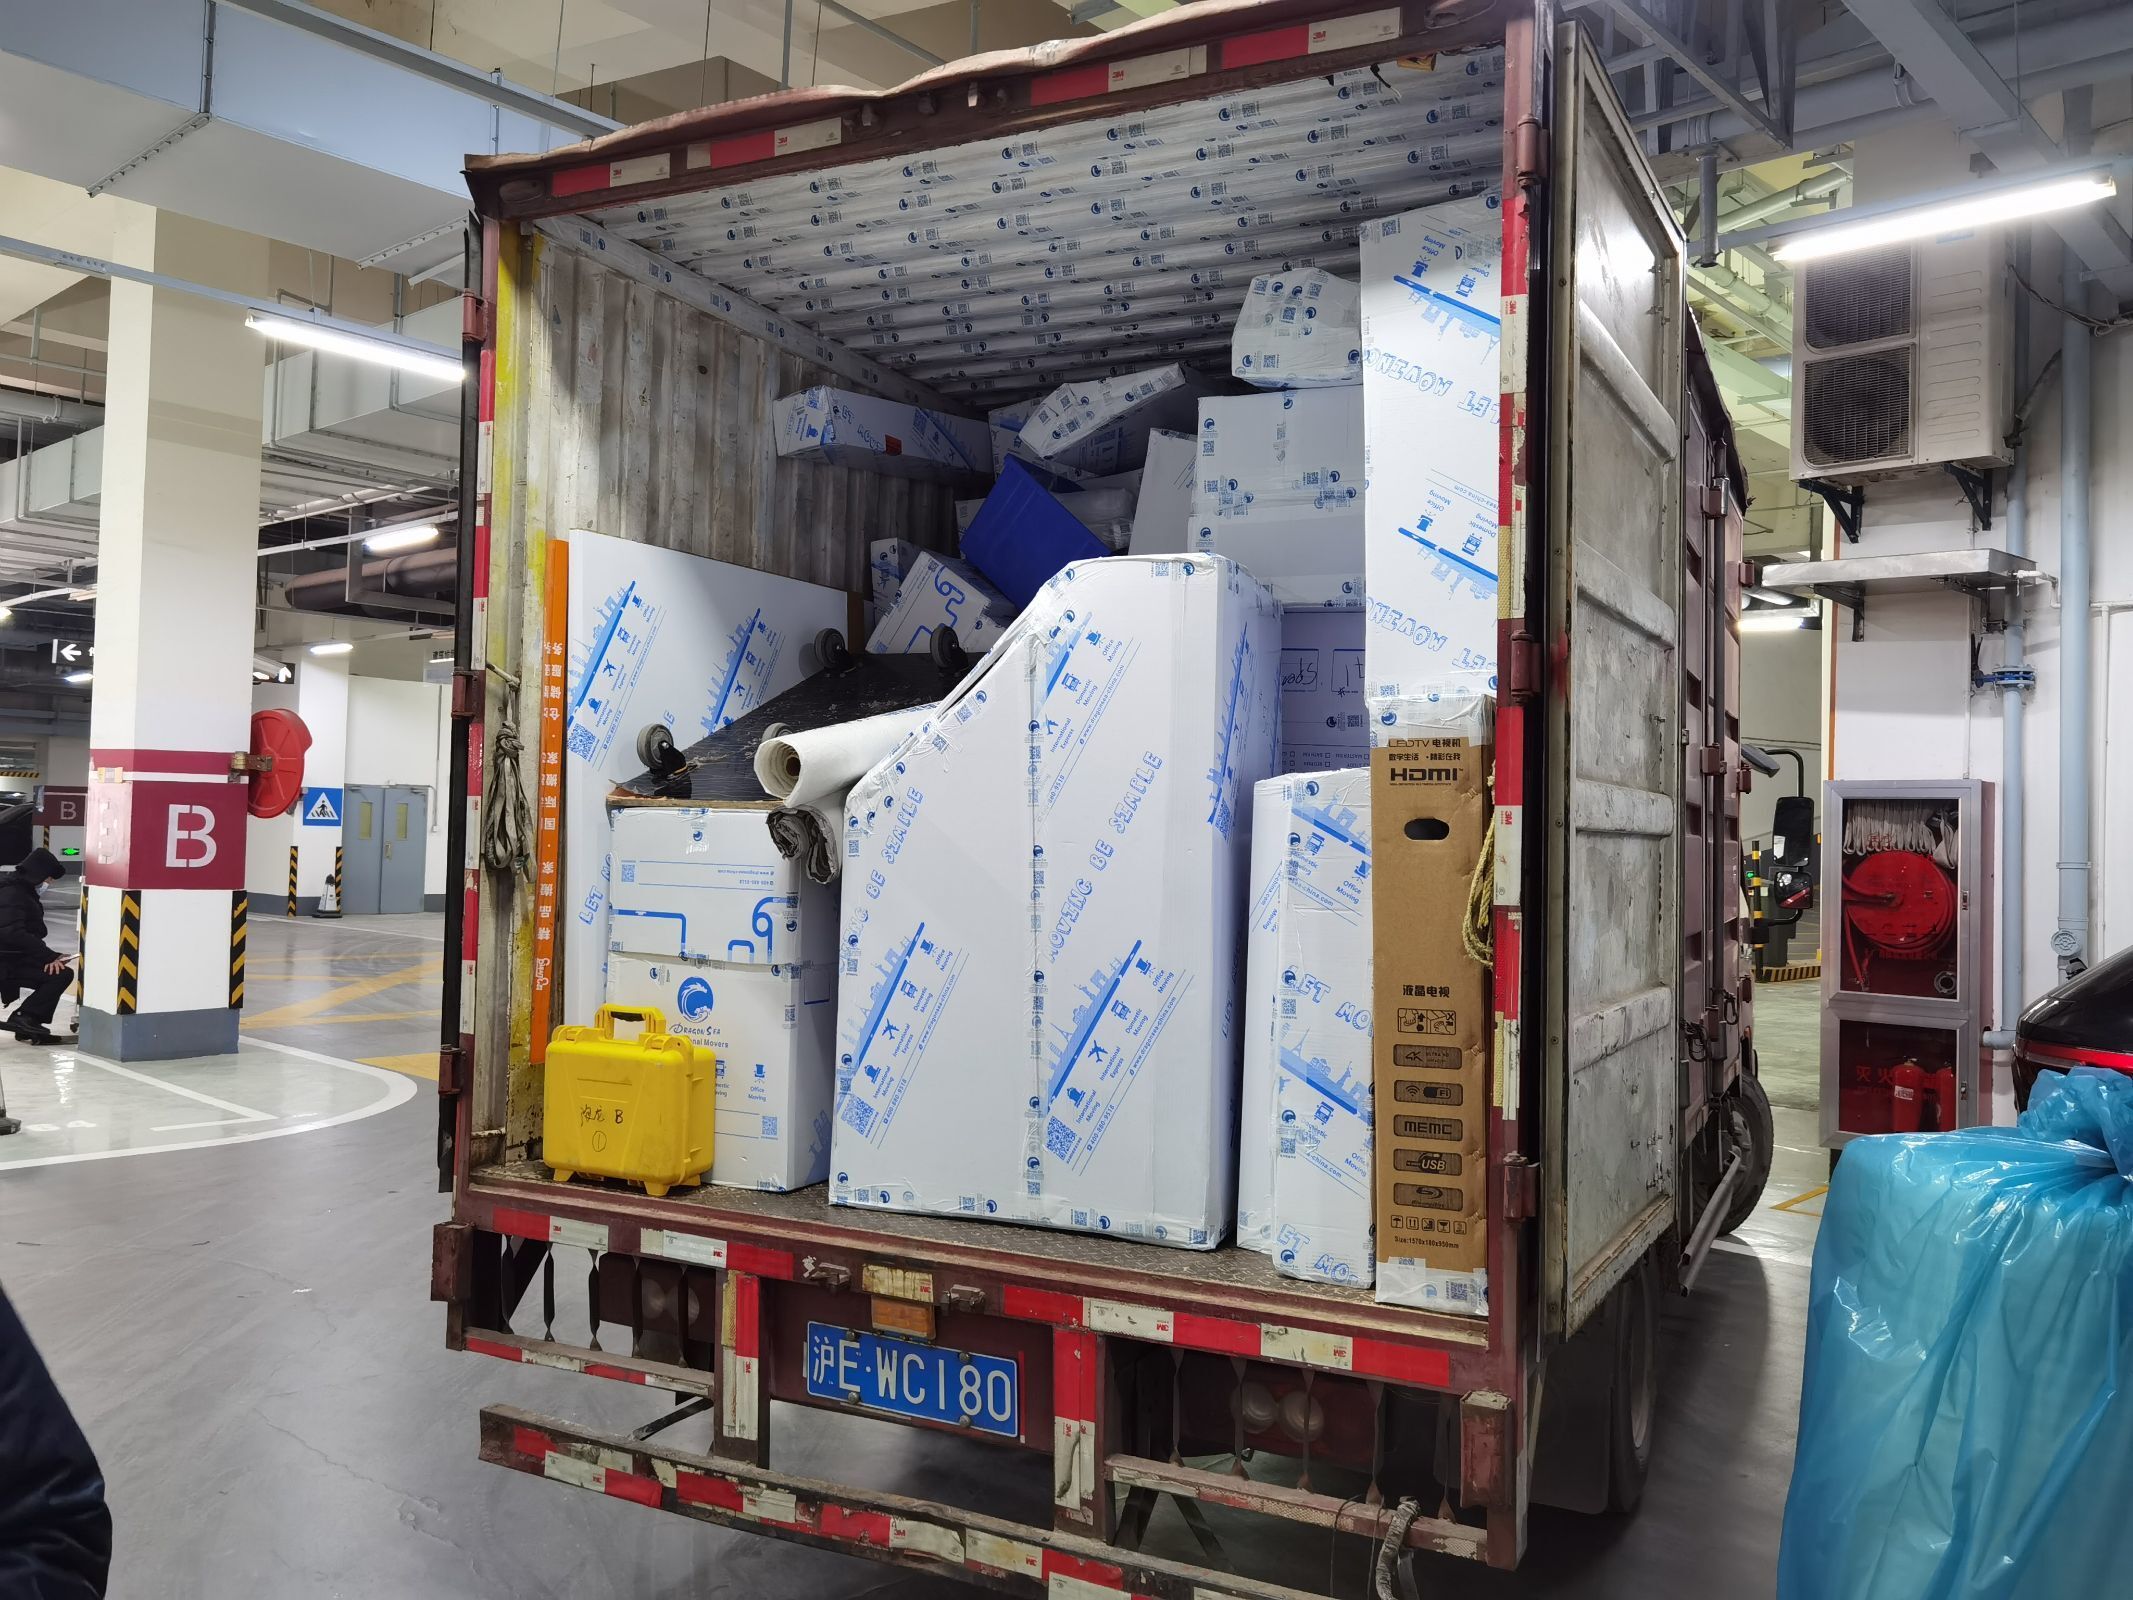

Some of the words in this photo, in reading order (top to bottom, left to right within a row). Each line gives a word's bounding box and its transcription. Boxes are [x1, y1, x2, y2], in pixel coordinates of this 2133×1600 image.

[1421, 245, 1439, 257] Office
[1423, 234, 1446, 249] Moving
[1510, 301, 1517, 314] 3M
[1426, 498, 1445, 512] Office
[1429, 489, 1452, 507] Moving
[1468, 520, 1497, 538] Domestic
[1475, 513, 1498, 529] Moving
[1102, 638, 1114, 656] Office
[1107, 640, 1123, 662] Moving
[1075, 678, 1093, 706] Domestic
[1083, 685, 1099, 707] Moving
[1050, 717, 1072, 753] International
[1061, 728, 1074, 750] Express
[1432, 738, 1461, 747] 电视机
[1389, 753, 1419, 761] 数字生活
[1390, 767, 1458, 781] HDMI
[60, 801, 77, 820] B
[1506, 811, 1513, 825] 3M
[165, 803, 218, 868] B
[865, 868, 887, 900] BE
[1343, 880, 1362, 895] Office
[1044, 878, 1093, 964] MOVING
[1089, 838, 1114, 872] BE
[1335, 886, 1361, 905] Moving
[578, 886, 605, 925] LET
[935, 949, 946, 966] Office
[939, 951, 953, 972] Moving
[1152, 969, 1165, 988] Office
[1158, 971, 1175, 994] Moving
[913, 986, 928, 1011] Domestic
[1402, 984, 1450, 998] 液晶电视
[920, 993, 933, 1013] Moving
[1125, 1008, 1143, 1035] Domestic
[1133, 1015, 1149, 1038] Moving
[704, 1039, 729, 1048] Movers
[892, 1023, 911, 1058] International
[902, 1034, 914, 1054] Express
[1099, 1045, 1121, 1082] International
[1109, 1057, 1125, 1080] Express
[872, 1065, 891, 1100] International
[882, 1076, 894, 1097] Moving
[747, 1093, 767, 1102] Moving
[1075, 1088, 1097, 1125] International
[615, 1109, 624, 1124] B
[1085, 1101, 1102, 1124] Moving
[1404, 1121, 1452, 1135] MEMC
[1421, 1159, 1446, 1171] USB
[1156, 1323, 1169, 1332] 3M
[1333, 1348, 1346, 1358] 3M
[813, 1335, 1012, 1422] 沪E·WC180
[1066, 1424, 1072, 1437] 3M
